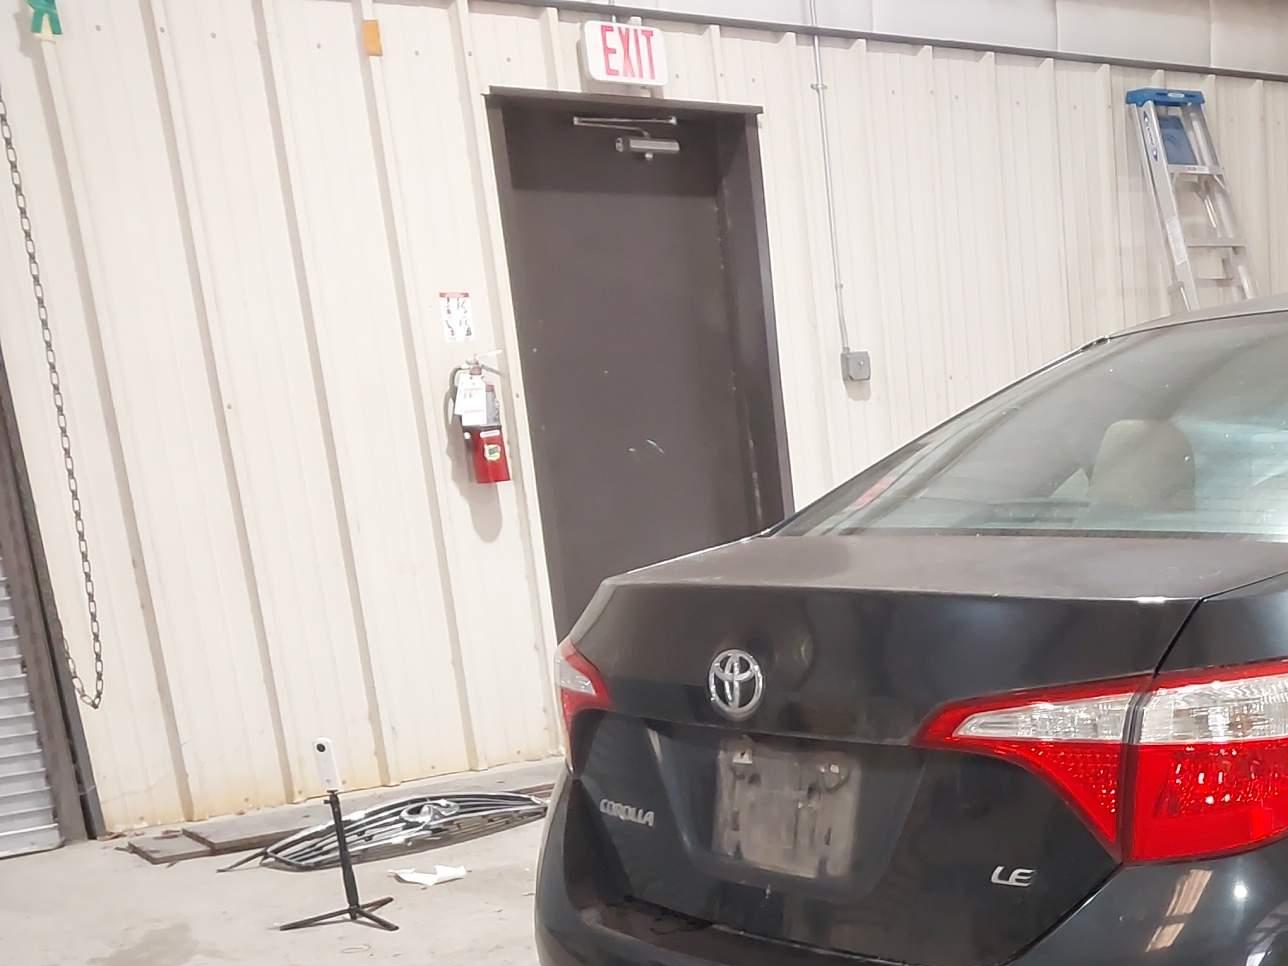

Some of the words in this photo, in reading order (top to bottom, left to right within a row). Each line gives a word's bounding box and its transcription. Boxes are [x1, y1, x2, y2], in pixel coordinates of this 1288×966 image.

[600, 25, 656, 80] EXIT
[599, 798, 655, 827] COROLLA
[991, 865, 1036, 887] LE
